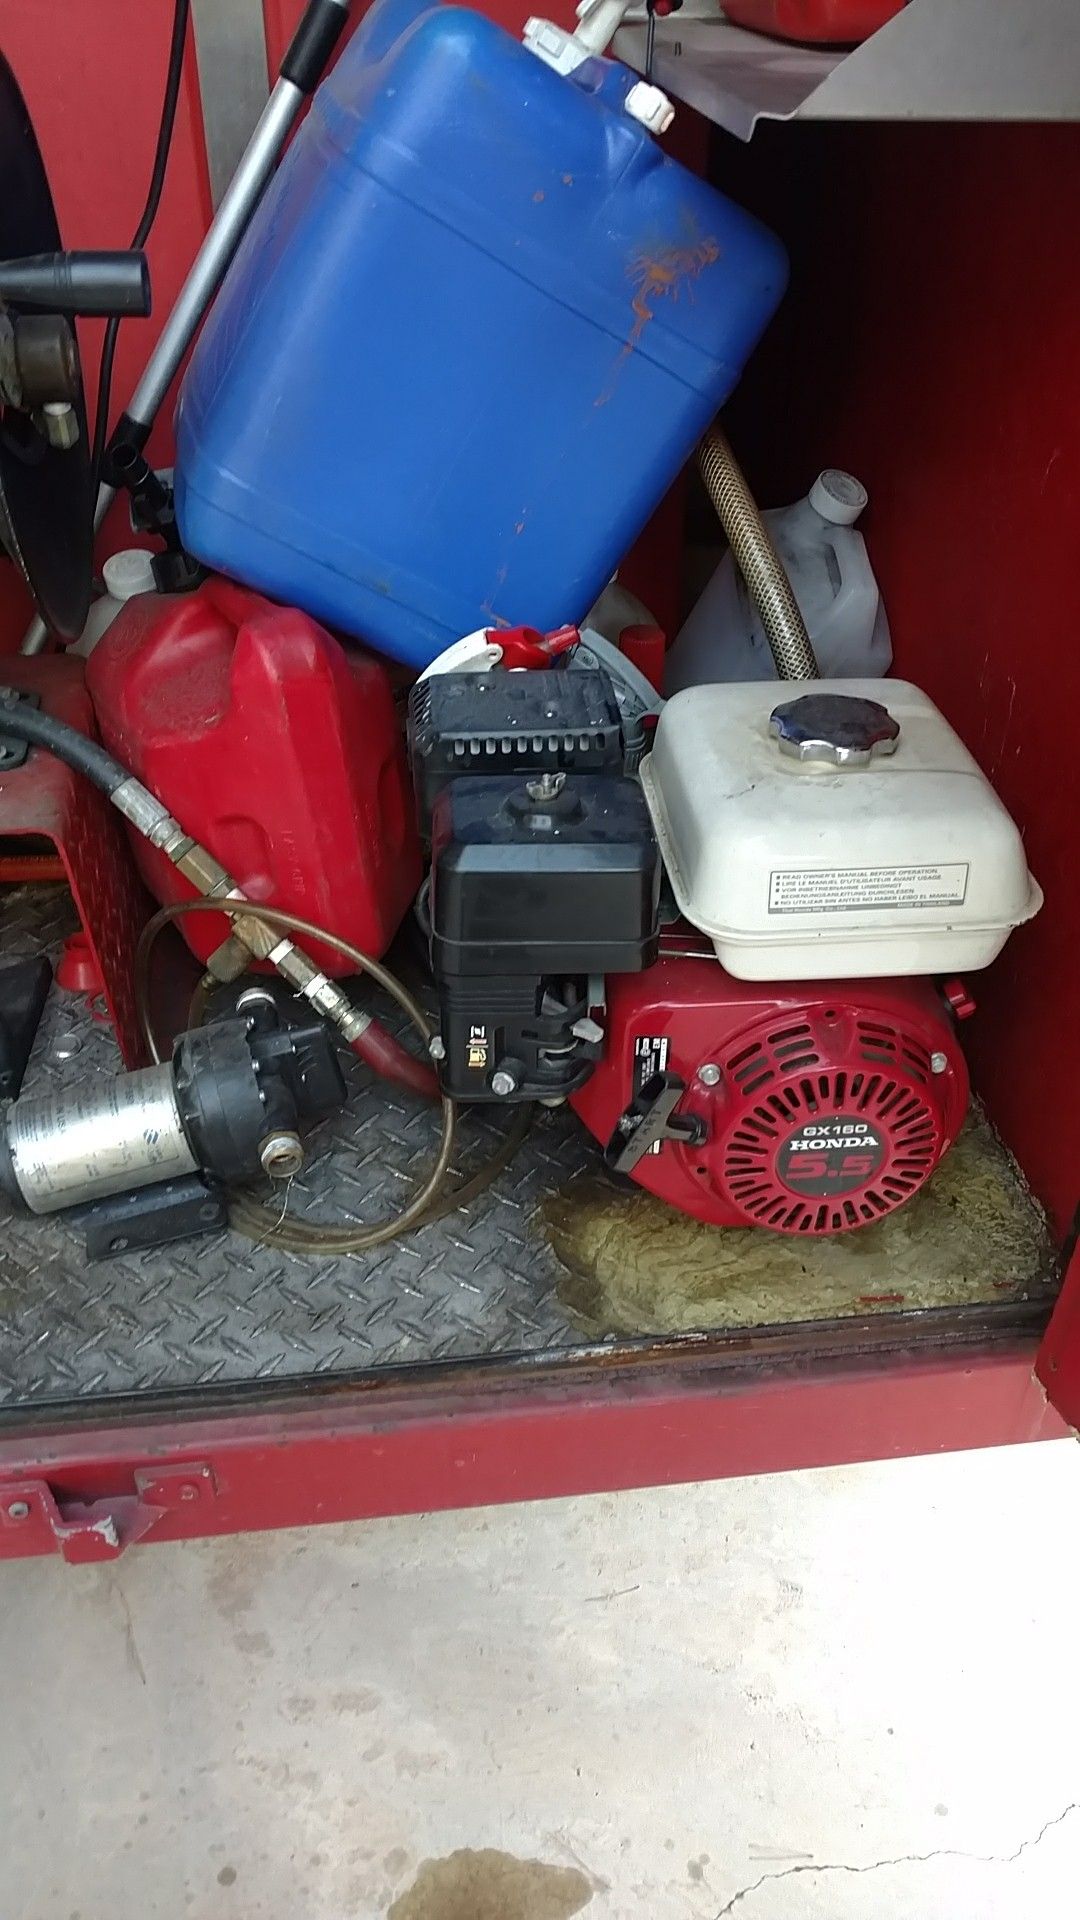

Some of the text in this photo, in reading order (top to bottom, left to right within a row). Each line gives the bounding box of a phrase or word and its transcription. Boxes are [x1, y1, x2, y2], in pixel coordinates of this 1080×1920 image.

[803, 1124, 868, 1136] GX160
[789, 1136, 879, 1151] HONDA
[786, 1152, 874, 1179] 5.5
